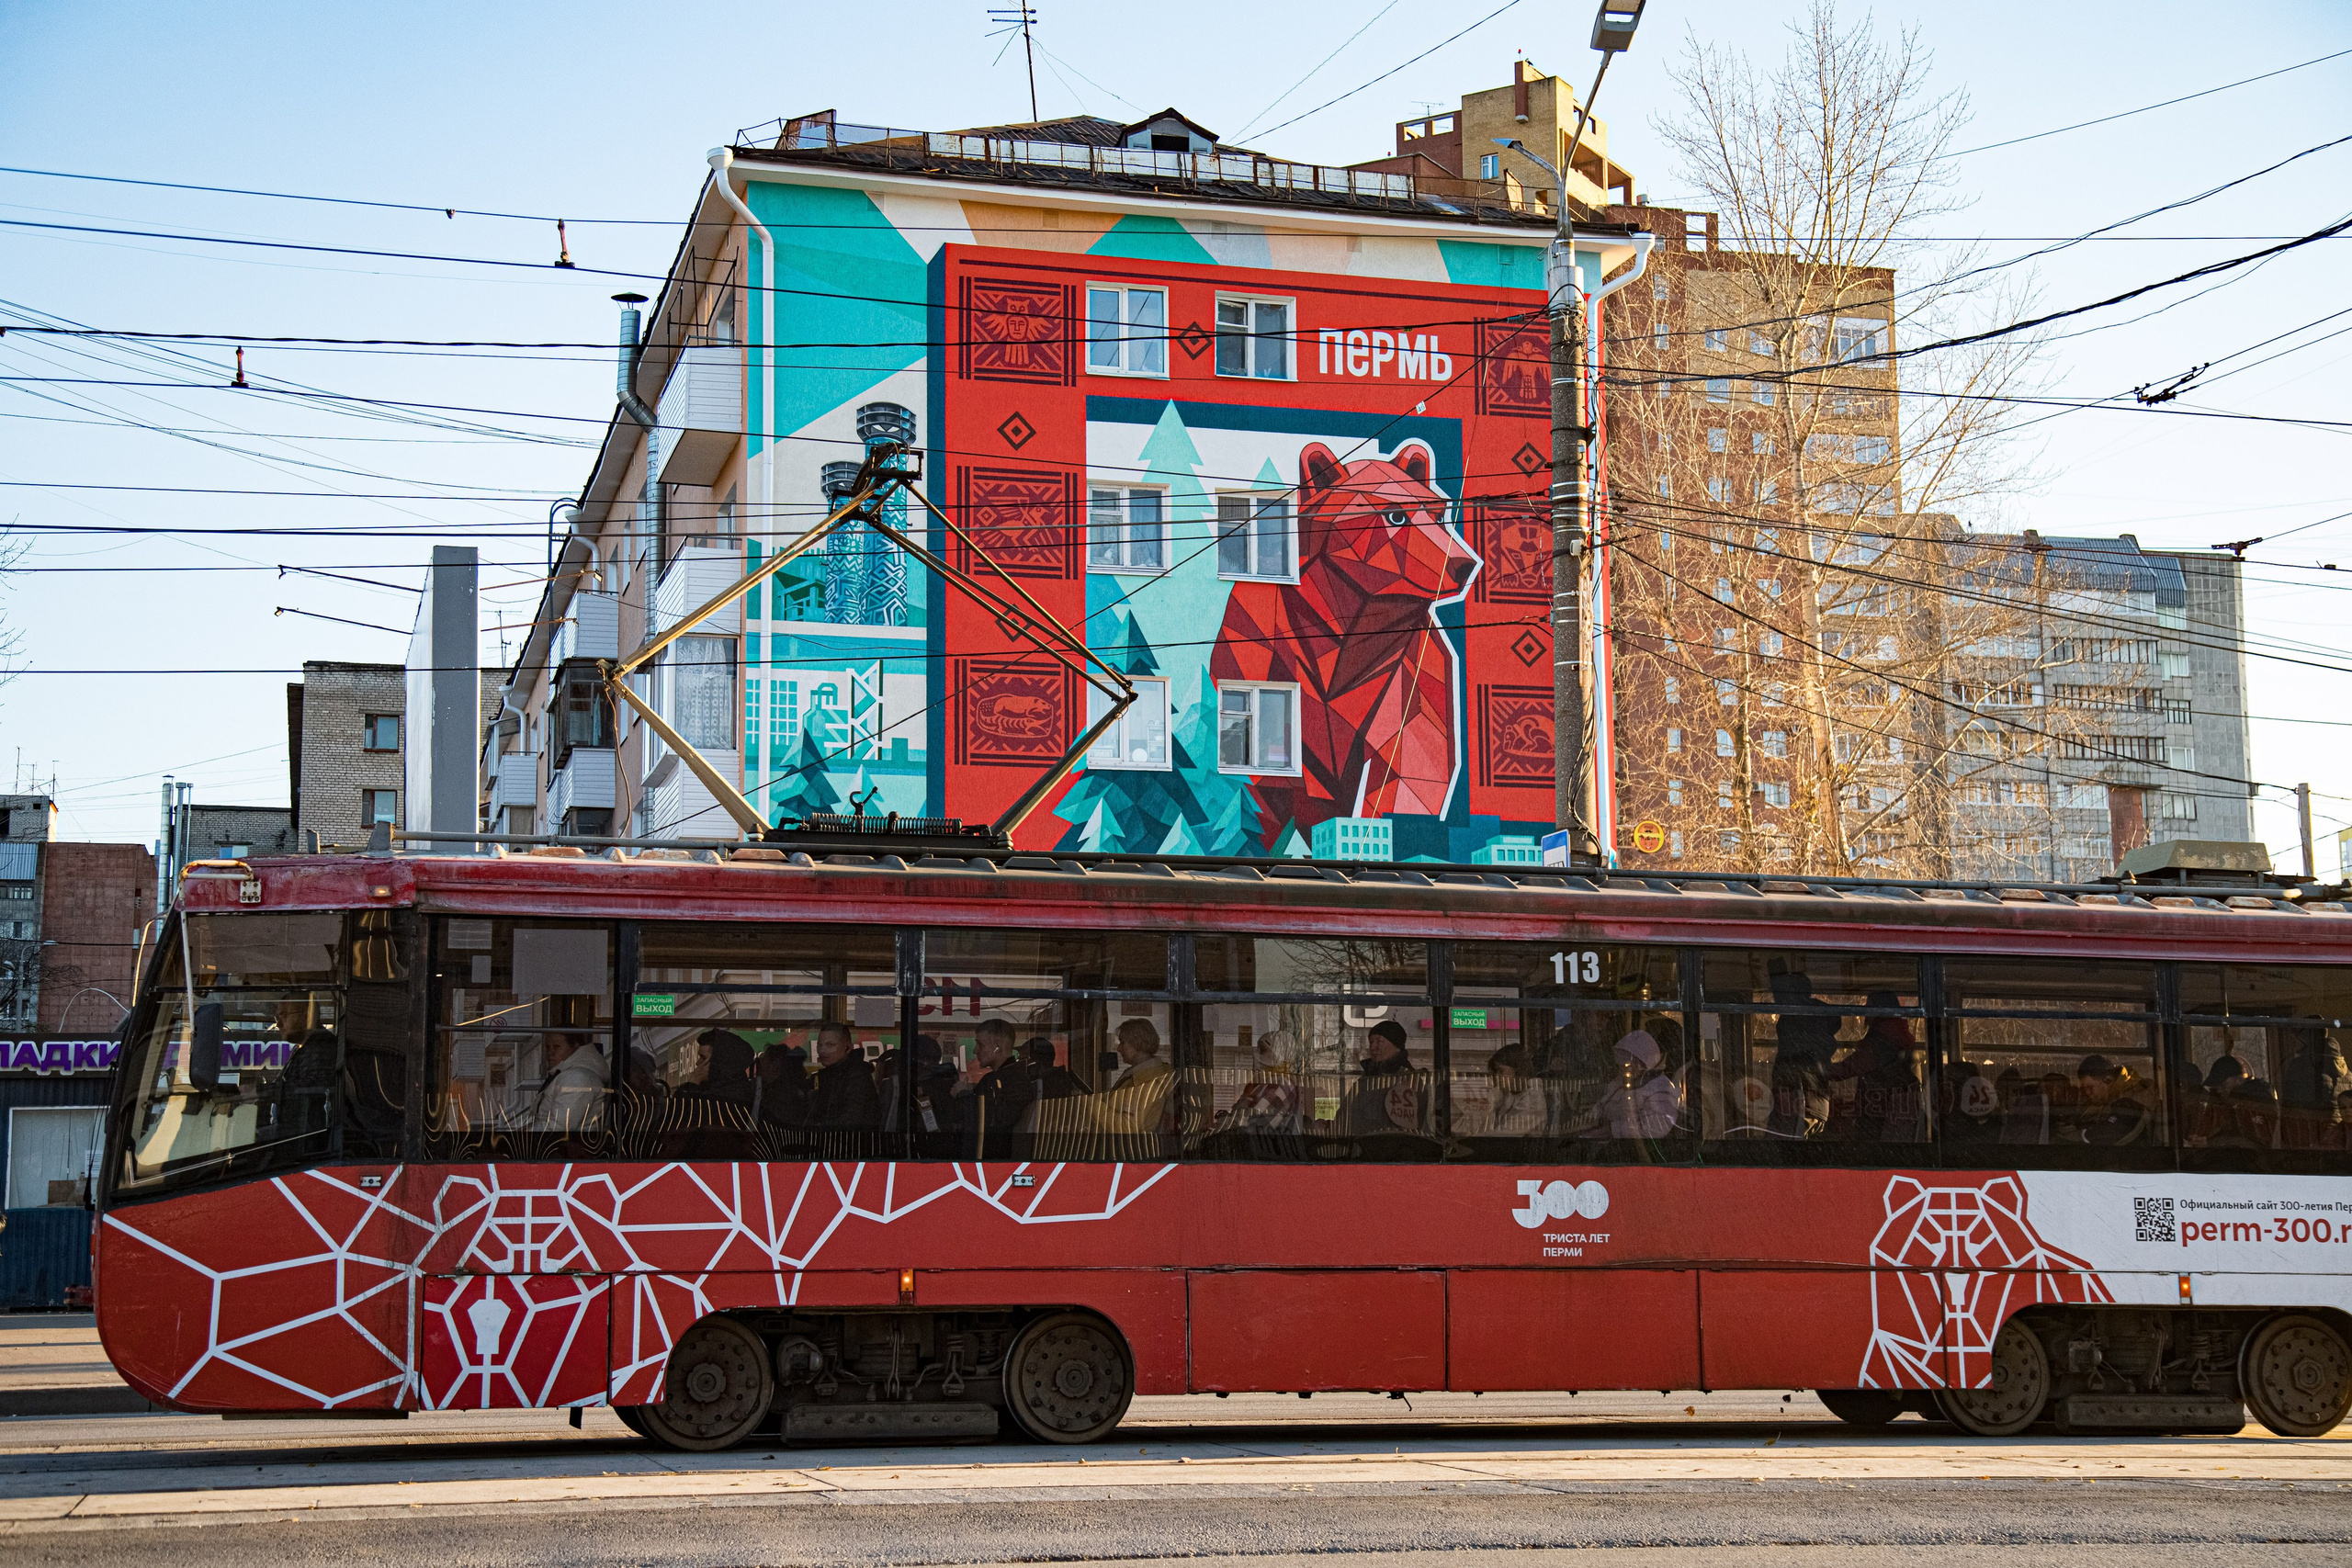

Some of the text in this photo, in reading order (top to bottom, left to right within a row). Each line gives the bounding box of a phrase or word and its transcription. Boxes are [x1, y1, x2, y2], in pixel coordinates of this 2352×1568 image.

[1550, 952, 1600, 984] 113
[636, 1005, 673, 1013] ВЫХОД
[1512, 1179, 1610, 1229] 300
[2180, 1199, 2254, 1212] Официальный
[2256, 1200, 2278, 1211] сайт
[2280, 1201, 2333, 1212] 300-летия
[1544, 1234, 1610, 1243] ТРИСТА ЛЕТ
[1544, 1247, 1582, 1257] ПЕРМИ
